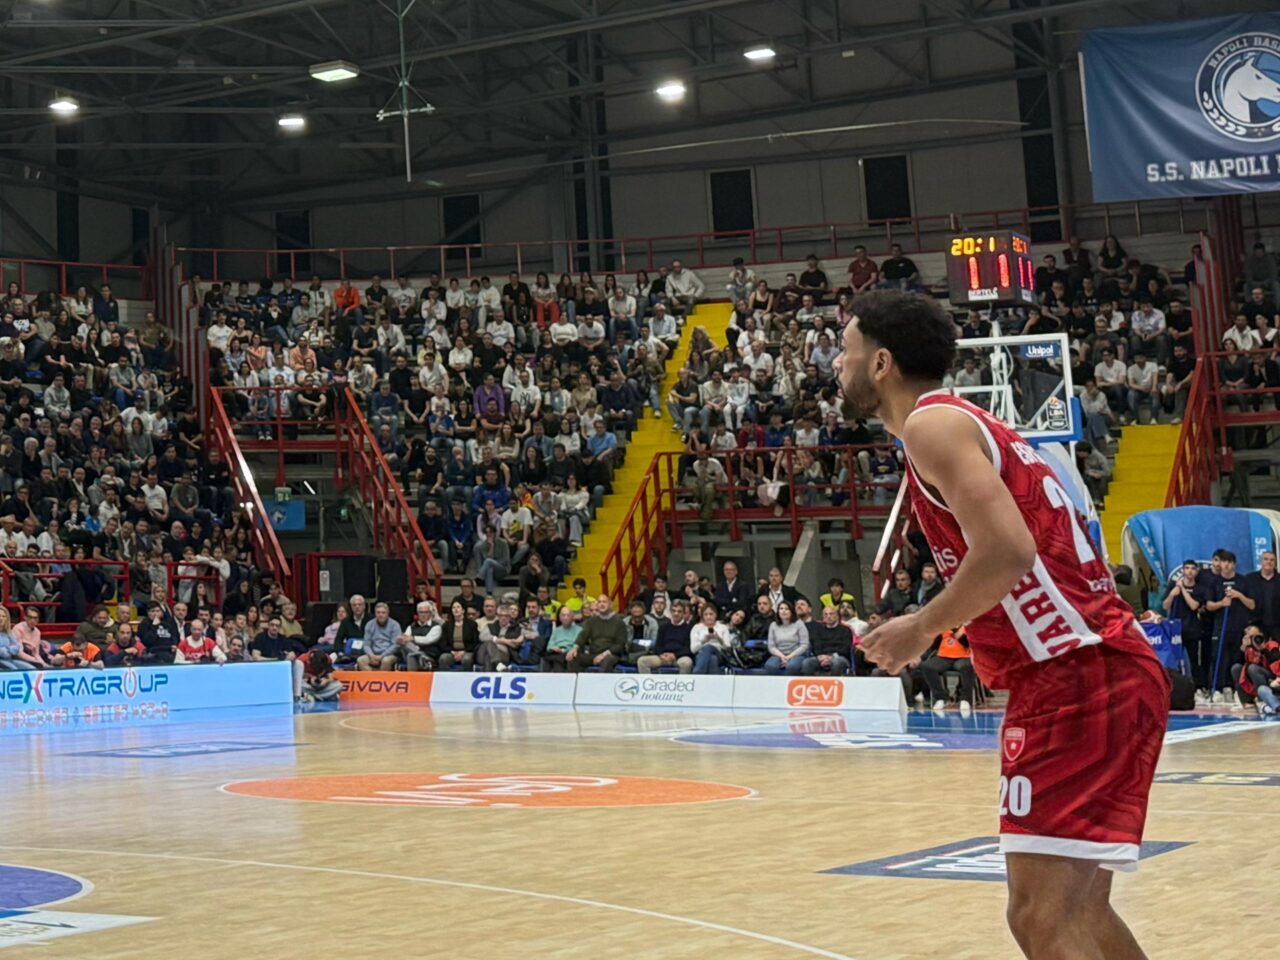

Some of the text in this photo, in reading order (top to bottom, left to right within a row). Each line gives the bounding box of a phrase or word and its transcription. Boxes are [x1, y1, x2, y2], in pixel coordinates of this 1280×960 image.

[1208, 37, 1248, 69] NAPOLI
[1146, 155, 1270, 182] S.S. NAPOLI
[1027, 344, 1055, 358] Unipol
[642, 677, 695, 692] Graded
[791, 680, 839, 706] gevi
[1000, 774, 1032, 817] 20
